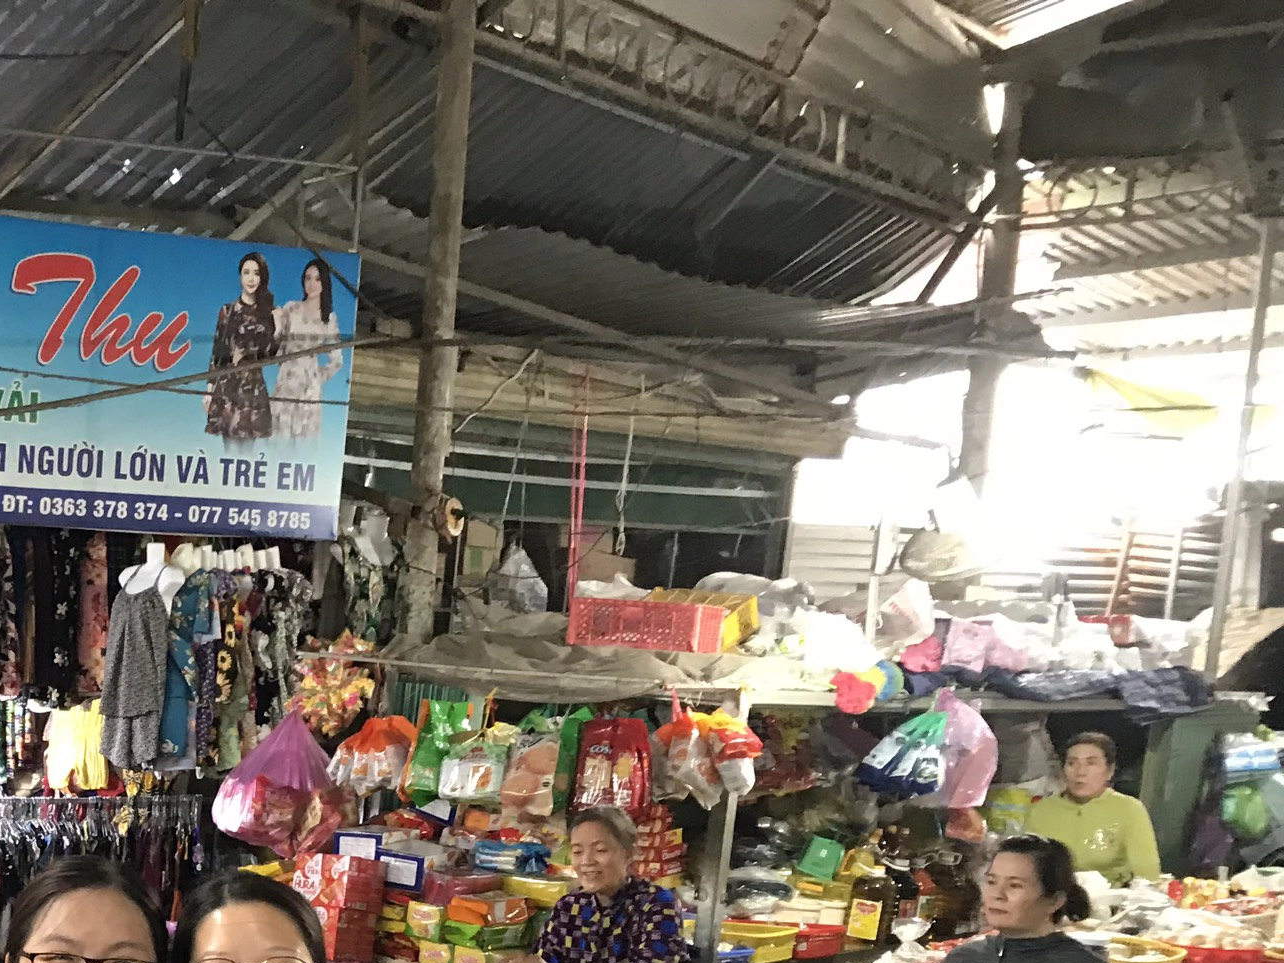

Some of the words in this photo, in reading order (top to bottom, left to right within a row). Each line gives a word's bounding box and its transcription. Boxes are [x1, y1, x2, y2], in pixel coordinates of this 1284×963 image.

[11, 252, 191, 372] Thu
[18, 441, 104, 480] NGƯỜI
[115, 445, 166, 482] LỚN
[177, 449, 210, 485] VÀ
[220, 453, 268, 489] TRẺ
[277, 463, 316, 492] EM
[2, 494, 33, 514] ĐT:
[40, 497, 87, 517] 0363
[93, 499, 128, 519] 378
[134, 502, 168, 521] 374
[188, 505, 223, 525] 077
[228, 507, 261, 527] 545
[267, 510, 311, 530] 8785
